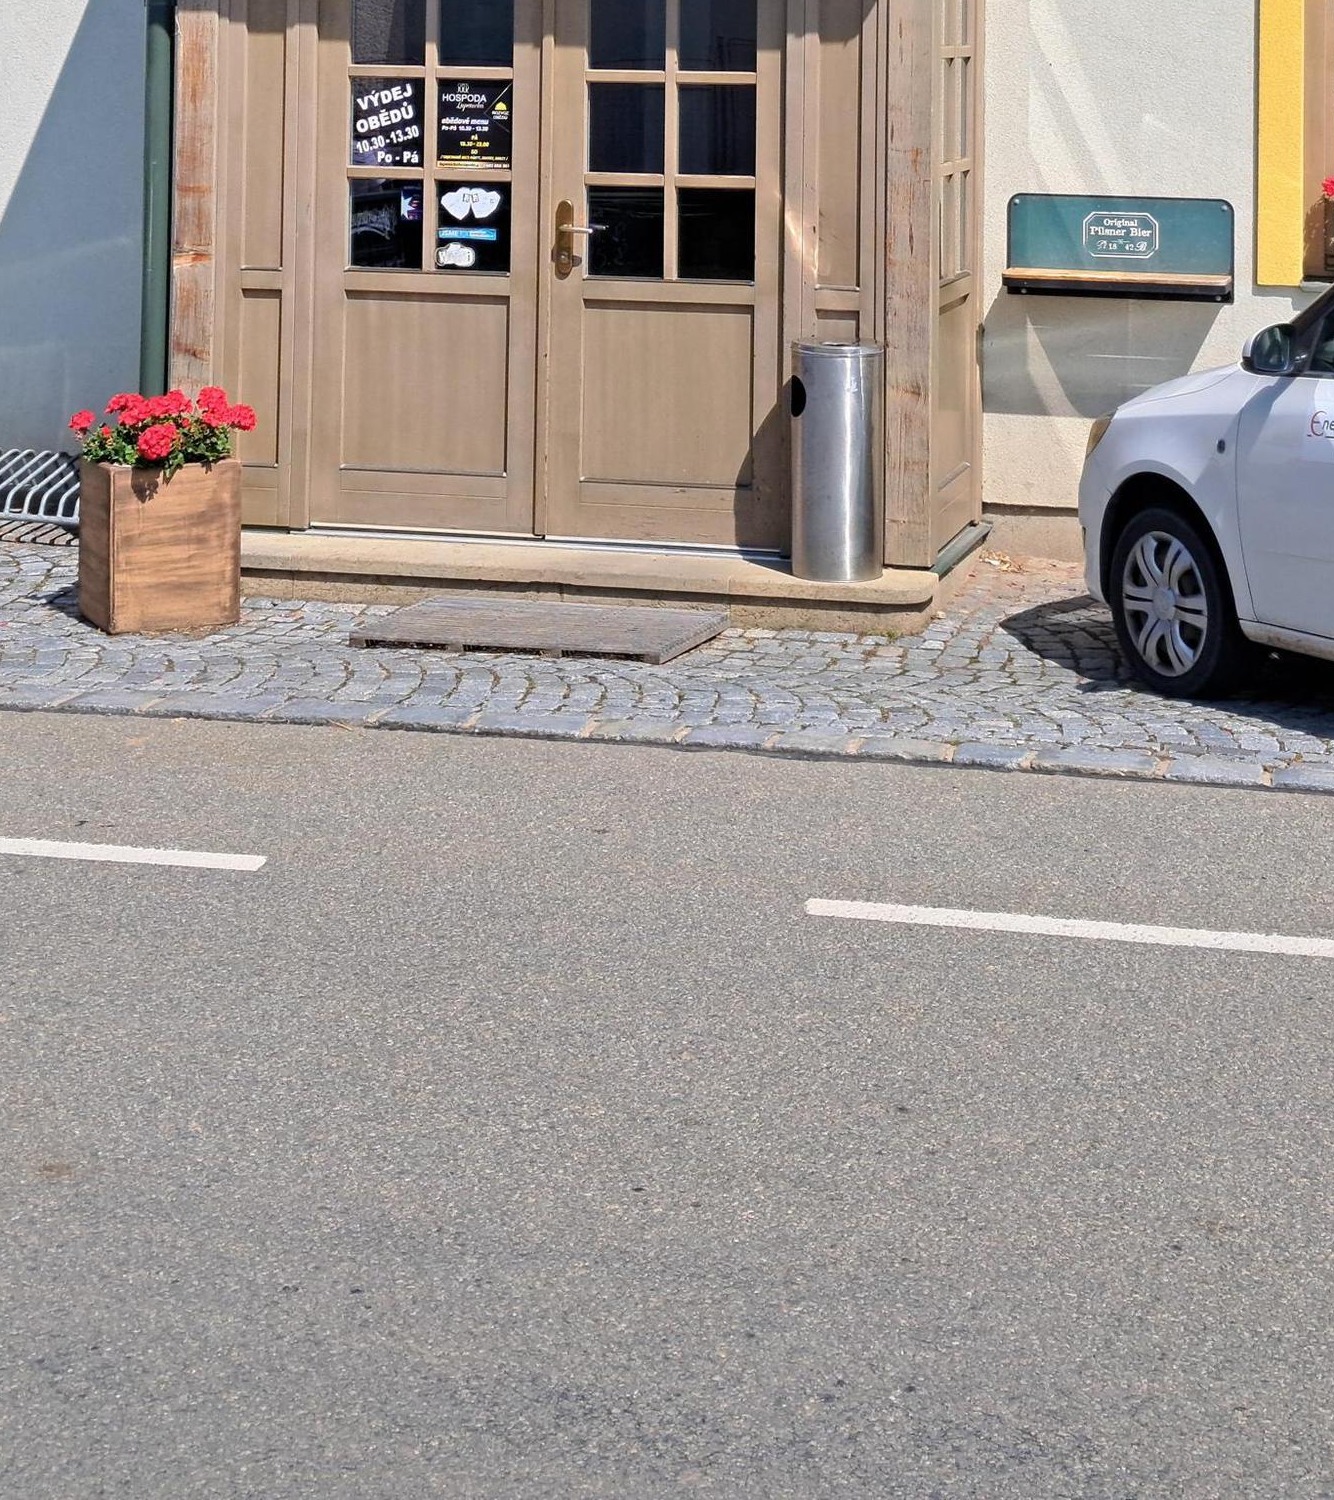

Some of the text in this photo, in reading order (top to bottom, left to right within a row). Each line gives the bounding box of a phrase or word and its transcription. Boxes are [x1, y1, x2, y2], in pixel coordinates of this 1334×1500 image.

[356, 83, 413, 110] VÝDEJ
[442, 93, 487, 103] HOSPODA
[356, 101, 414, 133] OBĚDŮ
[377, 151, 393, 163] Po
[403, 151, 419, 164] Pá
[1103, 218, 1138, 228] Original
[1090, 226, 1152, 237] Pilsner Bier
